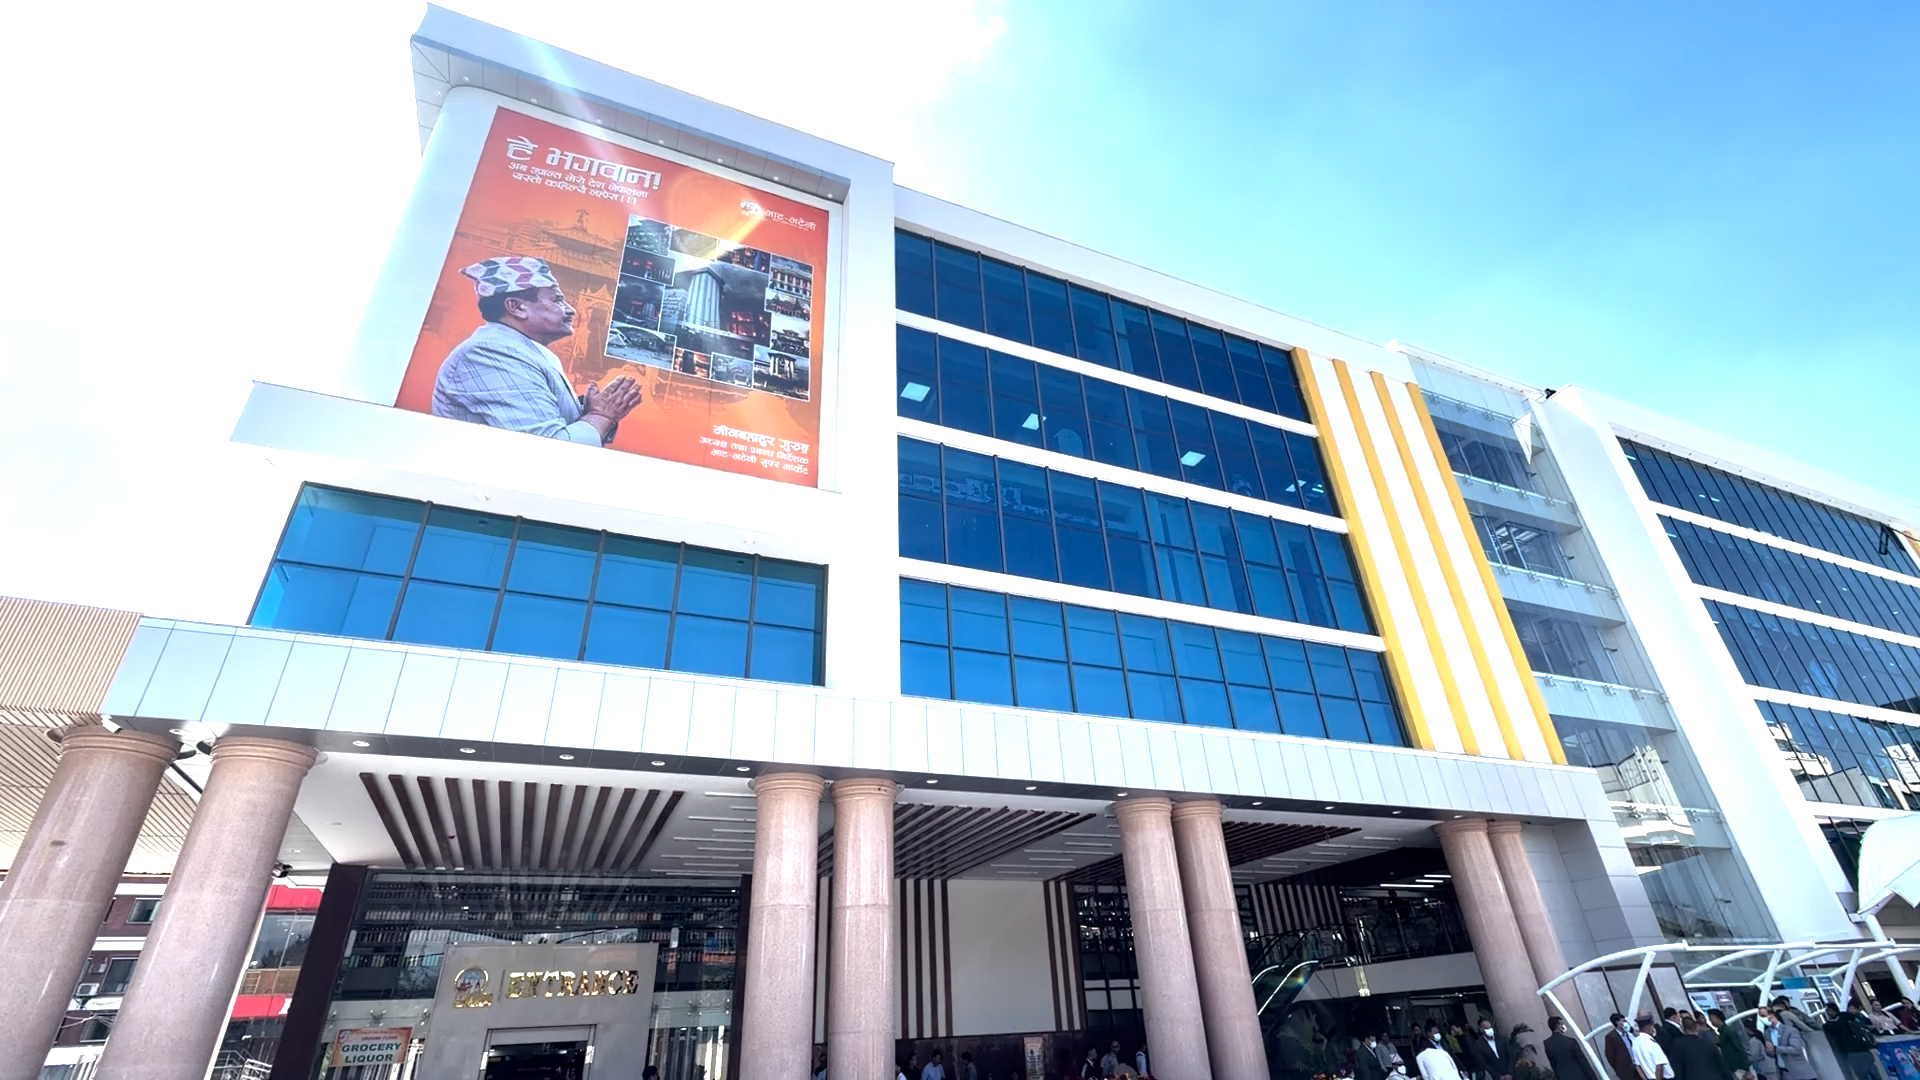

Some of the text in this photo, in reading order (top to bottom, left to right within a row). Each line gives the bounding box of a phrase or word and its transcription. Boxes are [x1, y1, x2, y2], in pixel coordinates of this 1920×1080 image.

[507, 135, 662, 189] हे भगवान!
[508, 161, 528, 172] अब
[588, 177, 605, 189] देश
[512, 171, 543, 185] यस्तो
[730, 442, 747, 453] तथा
[506, 969, 639, 999] ENTRANCE
[341, 1042, 402, 1053] GROCERY
[344, 1053, 394, 1064] LIQUOR
